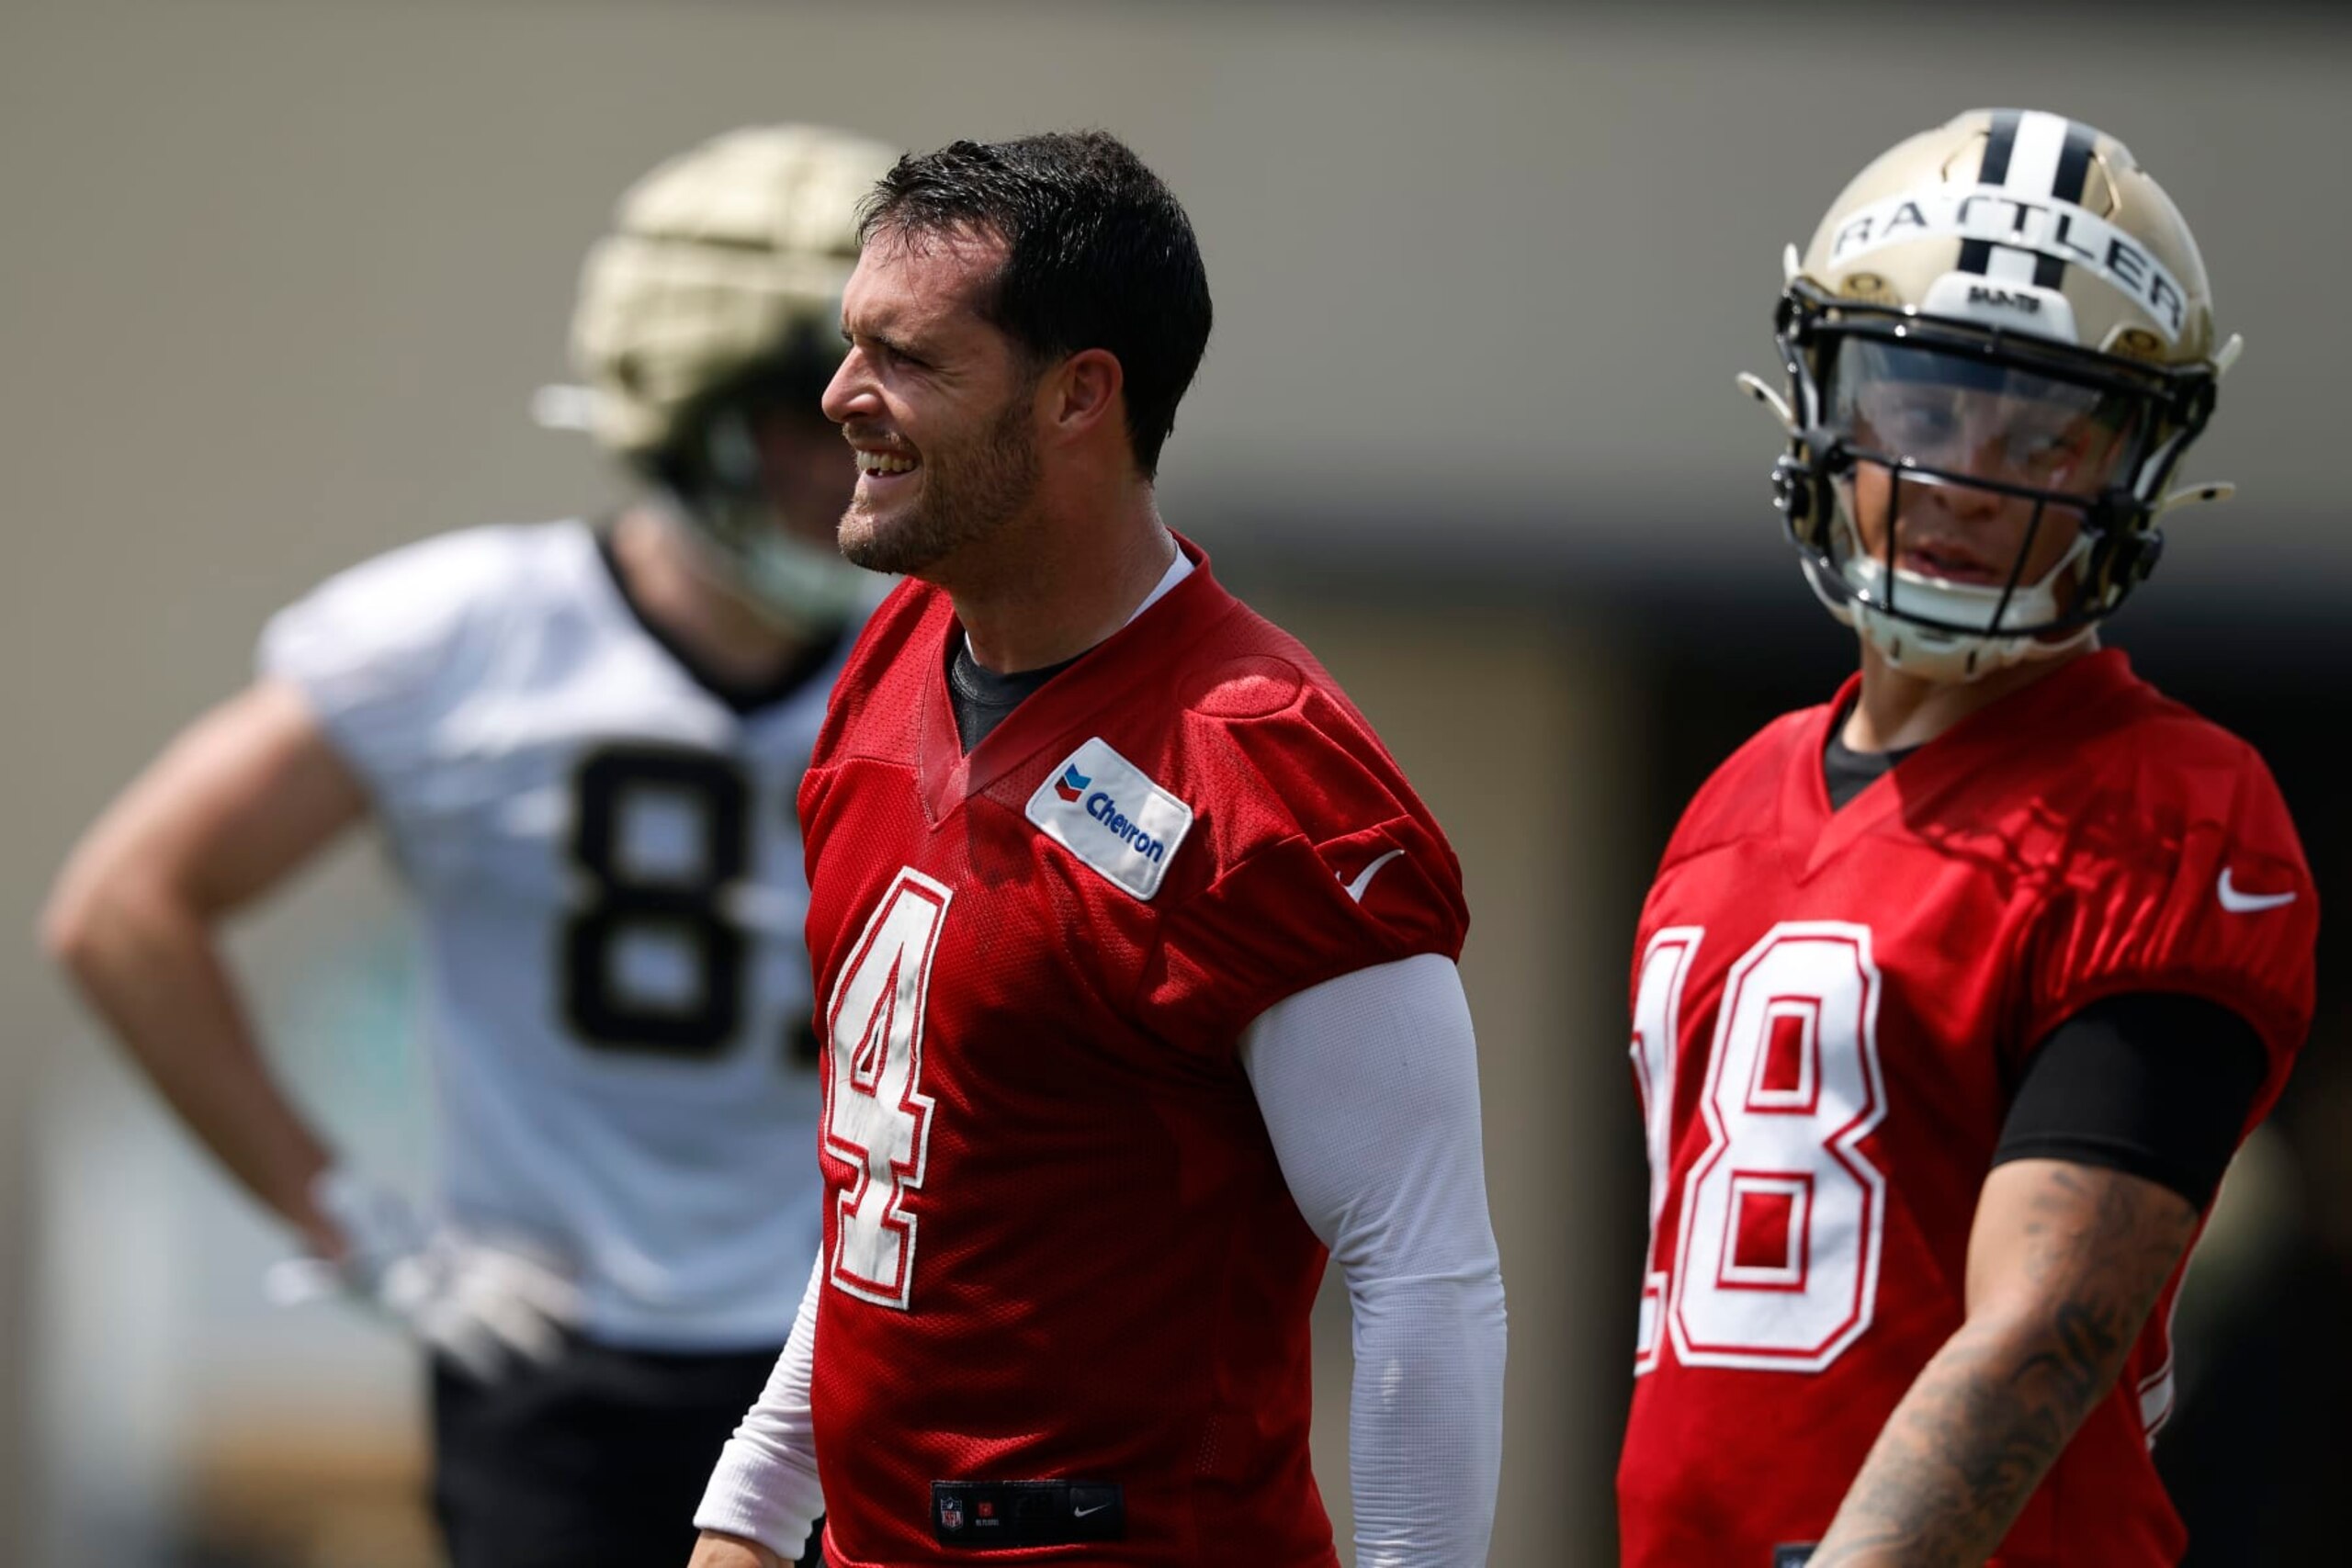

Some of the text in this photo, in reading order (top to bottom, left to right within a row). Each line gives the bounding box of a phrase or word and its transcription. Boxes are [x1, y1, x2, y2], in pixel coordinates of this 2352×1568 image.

[1835, 195, 2181, 328] RATTLER
[1086, 792, 1164, 863] Chevron
[825, 865, 953, 1309] 4
[1630, 920, 1887, 1377] 18
